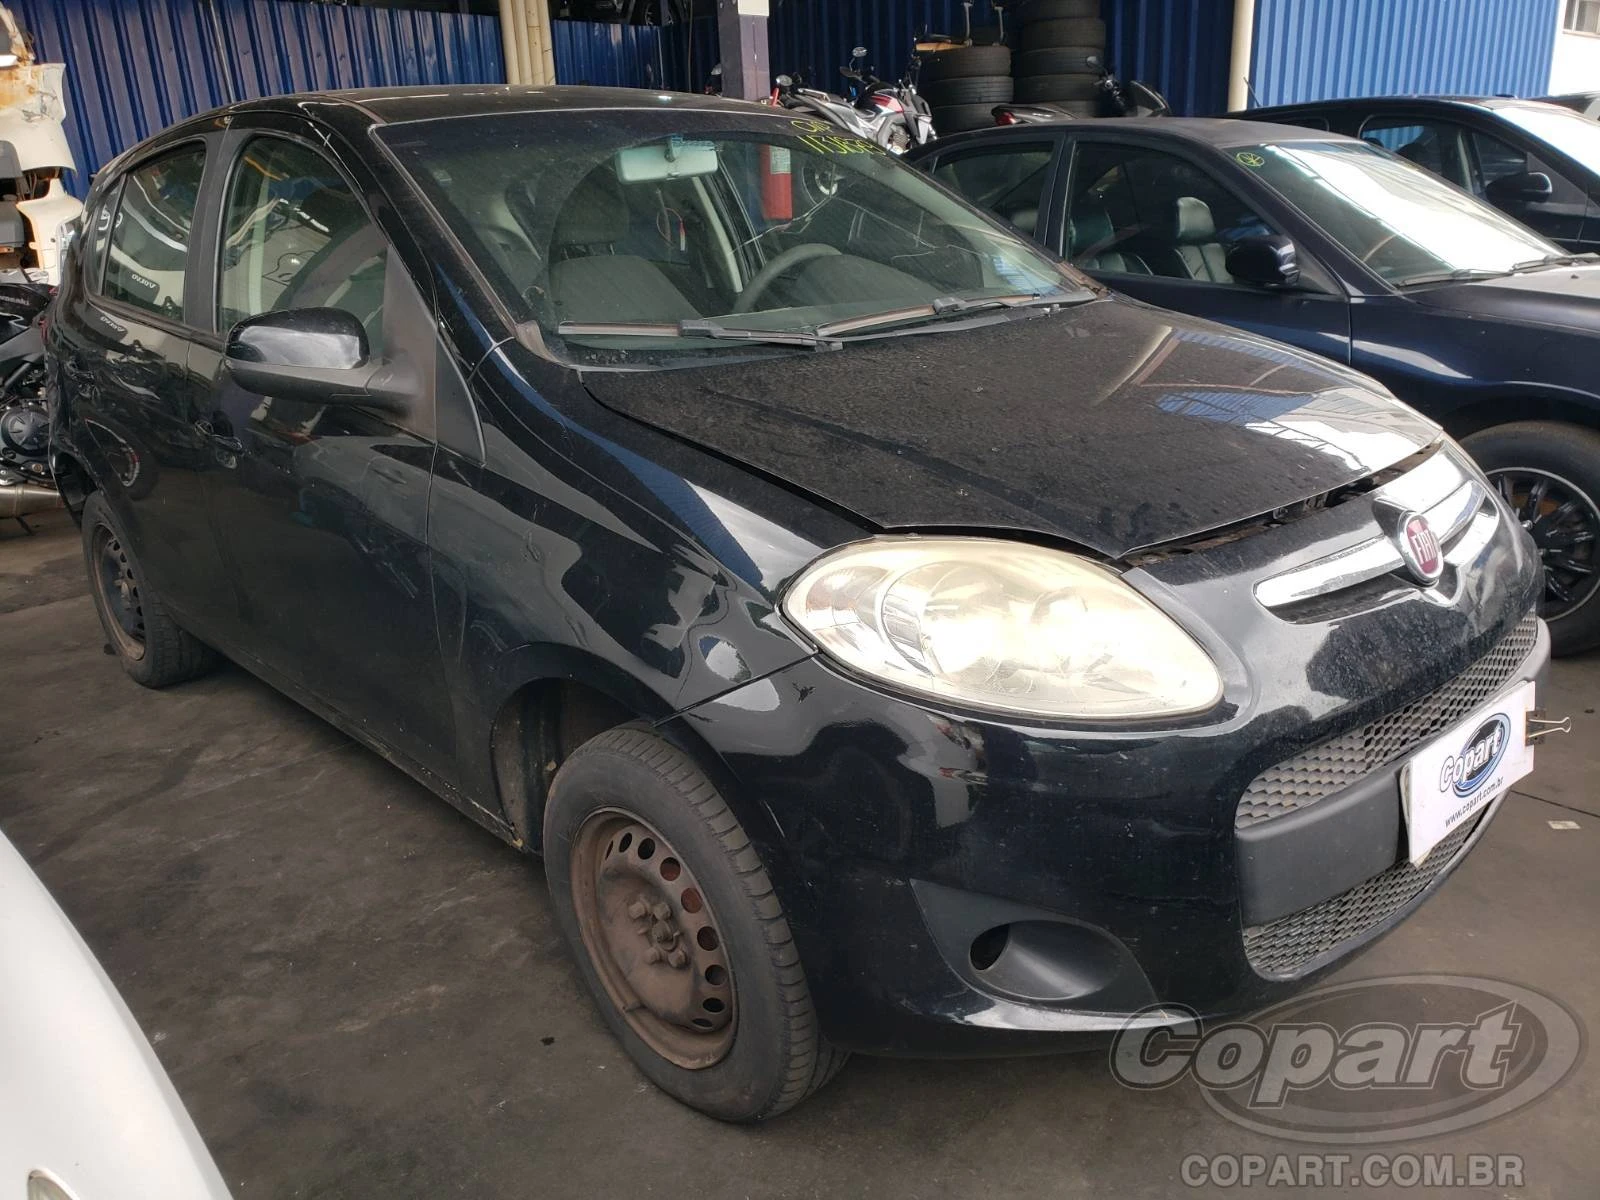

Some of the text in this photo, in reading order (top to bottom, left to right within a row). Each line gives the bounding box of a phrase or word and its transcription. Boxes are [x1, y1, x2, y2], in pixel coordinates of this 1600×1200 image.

[1409, 528, 1437, 565] FIAT
[1440, 720, 1503, 793] Copart
[1445, 776, 1504, 828] www.copart.com.br
